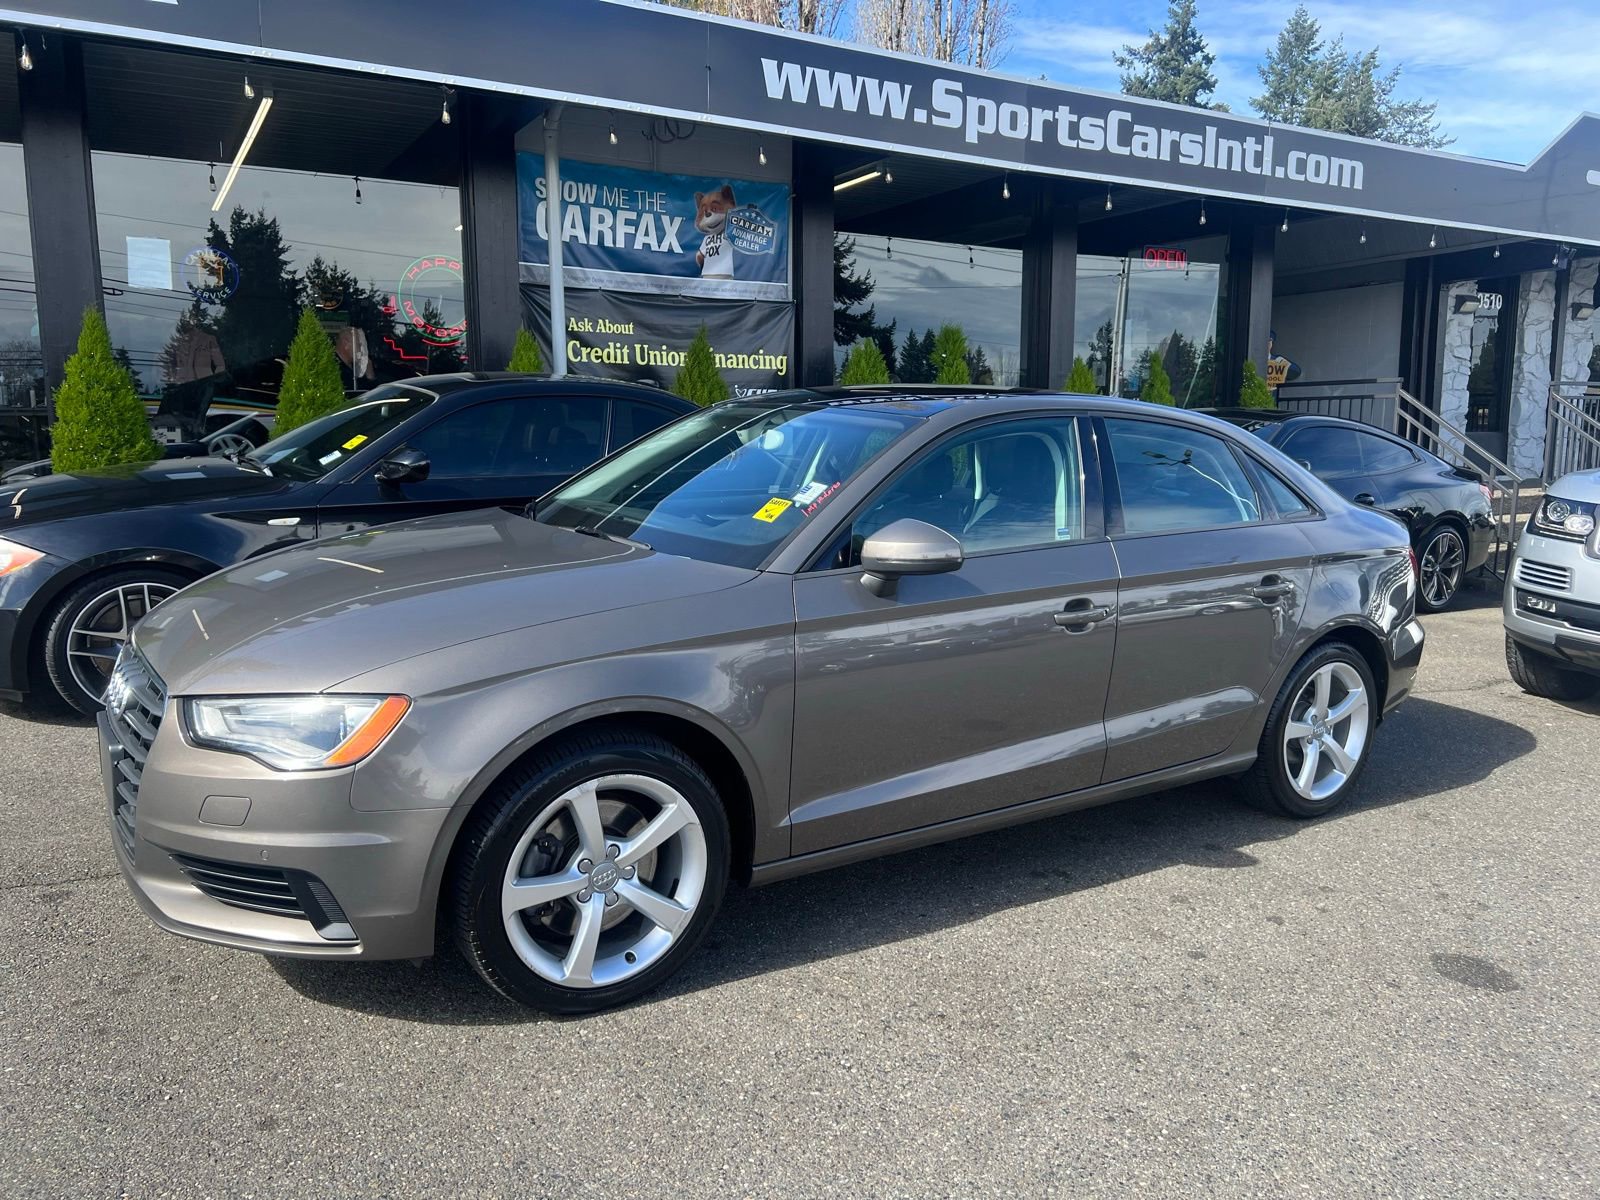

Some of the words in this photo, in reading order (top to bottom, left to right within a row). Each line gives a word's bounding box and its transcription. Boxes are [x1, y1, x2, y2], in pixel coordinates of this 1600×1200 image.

[760, 57, 1364, 190] www.SportsCarsIntl.com
[535, 177, 597, 204] SOW
[603, 186, 630, 209] ME
[633, 190, 666, 213] THE
[536, 200, 683, 253] CARFAX
[731, 216, 773, 237] CARFAX
[731, 227, 768, 246] ADVANTAGE
[705, 233, 723, 246] CAR
[734, 238, 760, 252] DEALER
[705, 244, 721, 257] FOX
[1145, 248, 1185, 270] OPEN
[407, 258, 461, 279] HAPP
[568, 317, 594, 333] Ask
[595, 319, 634, 335] About
[567, 340, 630, 365] Credit
[708, 347, 788, 376] nancing
[1267, 365, 1286, 375] OW
